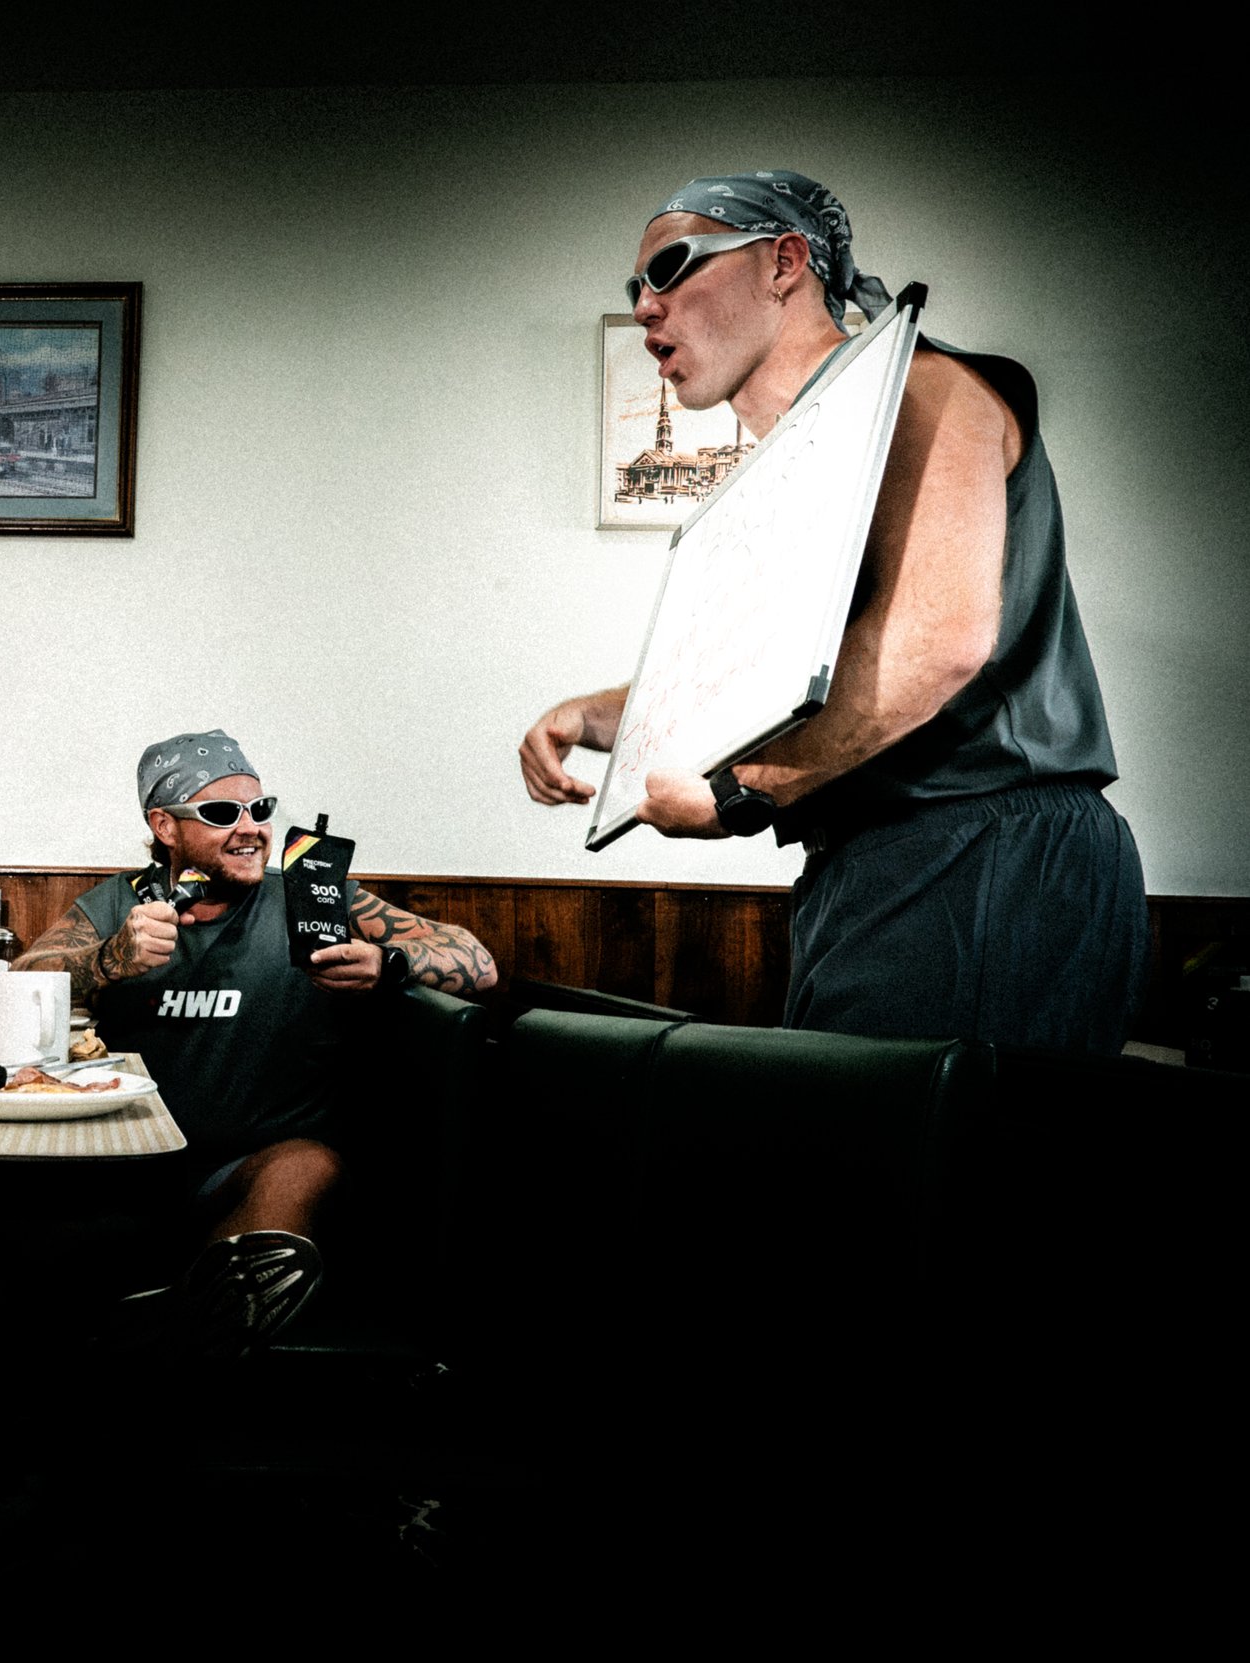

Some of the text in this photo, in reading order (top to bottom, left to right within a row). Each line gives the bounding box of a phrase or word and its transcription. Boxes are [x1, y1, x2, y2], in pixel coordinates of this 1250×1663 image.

[316, 896, 336, 905] carb
[298, 920, 332, 933] FLOW
[157, 989, 242, 1018] HWD
